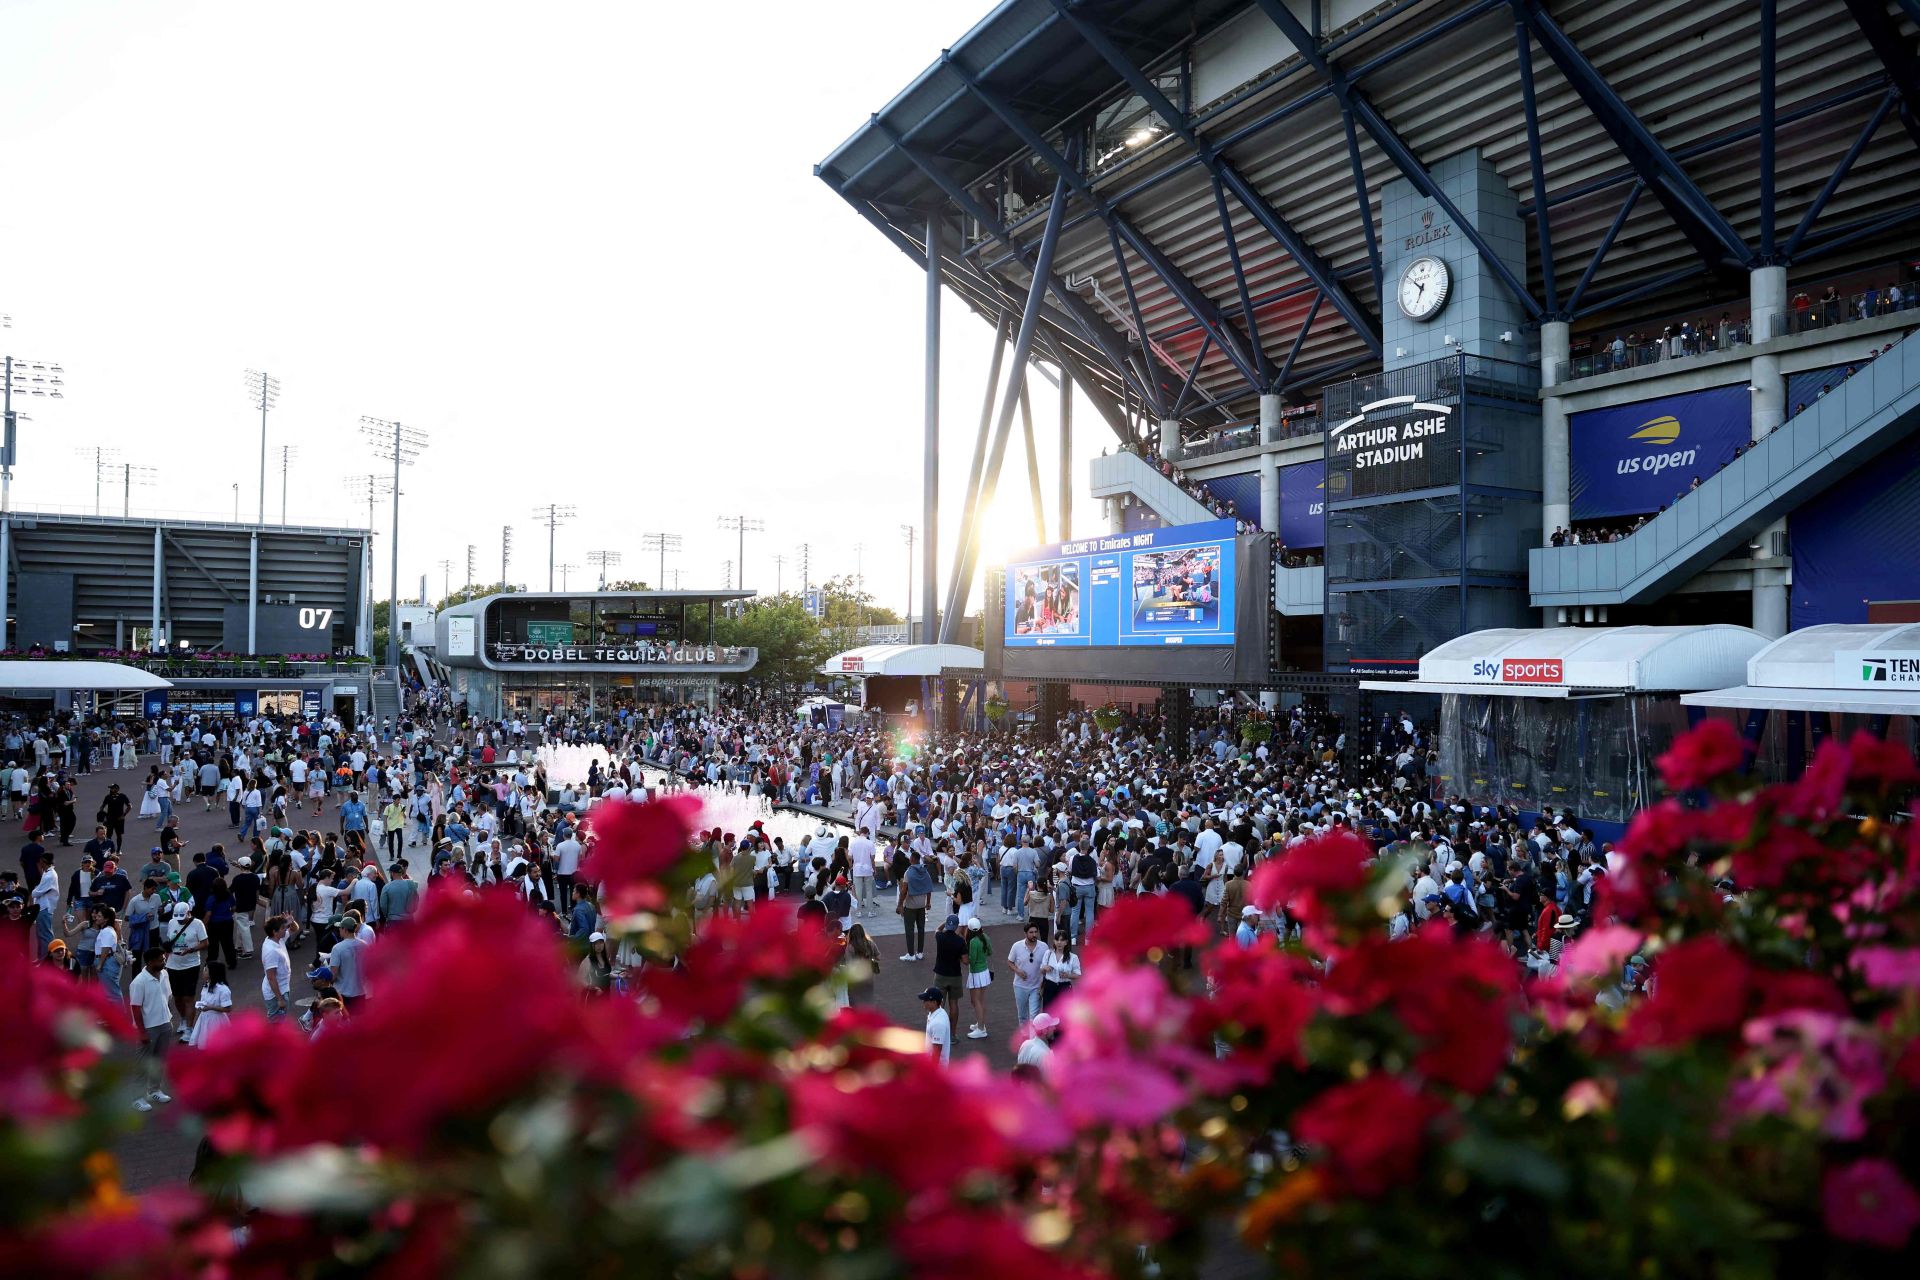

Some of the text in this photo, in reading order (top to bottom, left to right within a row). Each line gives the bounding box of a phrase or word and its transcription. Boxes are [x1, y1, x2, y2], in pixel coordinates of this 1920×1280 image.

[1405, 225, 1451, 250] ROLEX
[1337, 416, 1446, 451] ARTHUR ASHE
[1356, 442, 1423, 468] STADIUM
[1617, 449, 1696, 475] us open
[1309, 503, 1324, 515] us
[1061, 533, 1154, 555] WELCOME TO Emirates NIGHT
[299, 607, 333, 630] 07
[525, 649, 588, 660] DOBEL
[595, 650, 667, 661] TEQUILA
[674, 650, 716, 662] CLUB
[842, 656, 864, 671] ESPN
[1889, 659, 1920, 672] TEN
[189, 668, 262, 678] EXPRESS
[268, 669, 306, 678] SHOP
[1473, 660, 1560, 680] sky sports
[651, 678, 674, 687] open
[674, 676, 717, 685] collection
